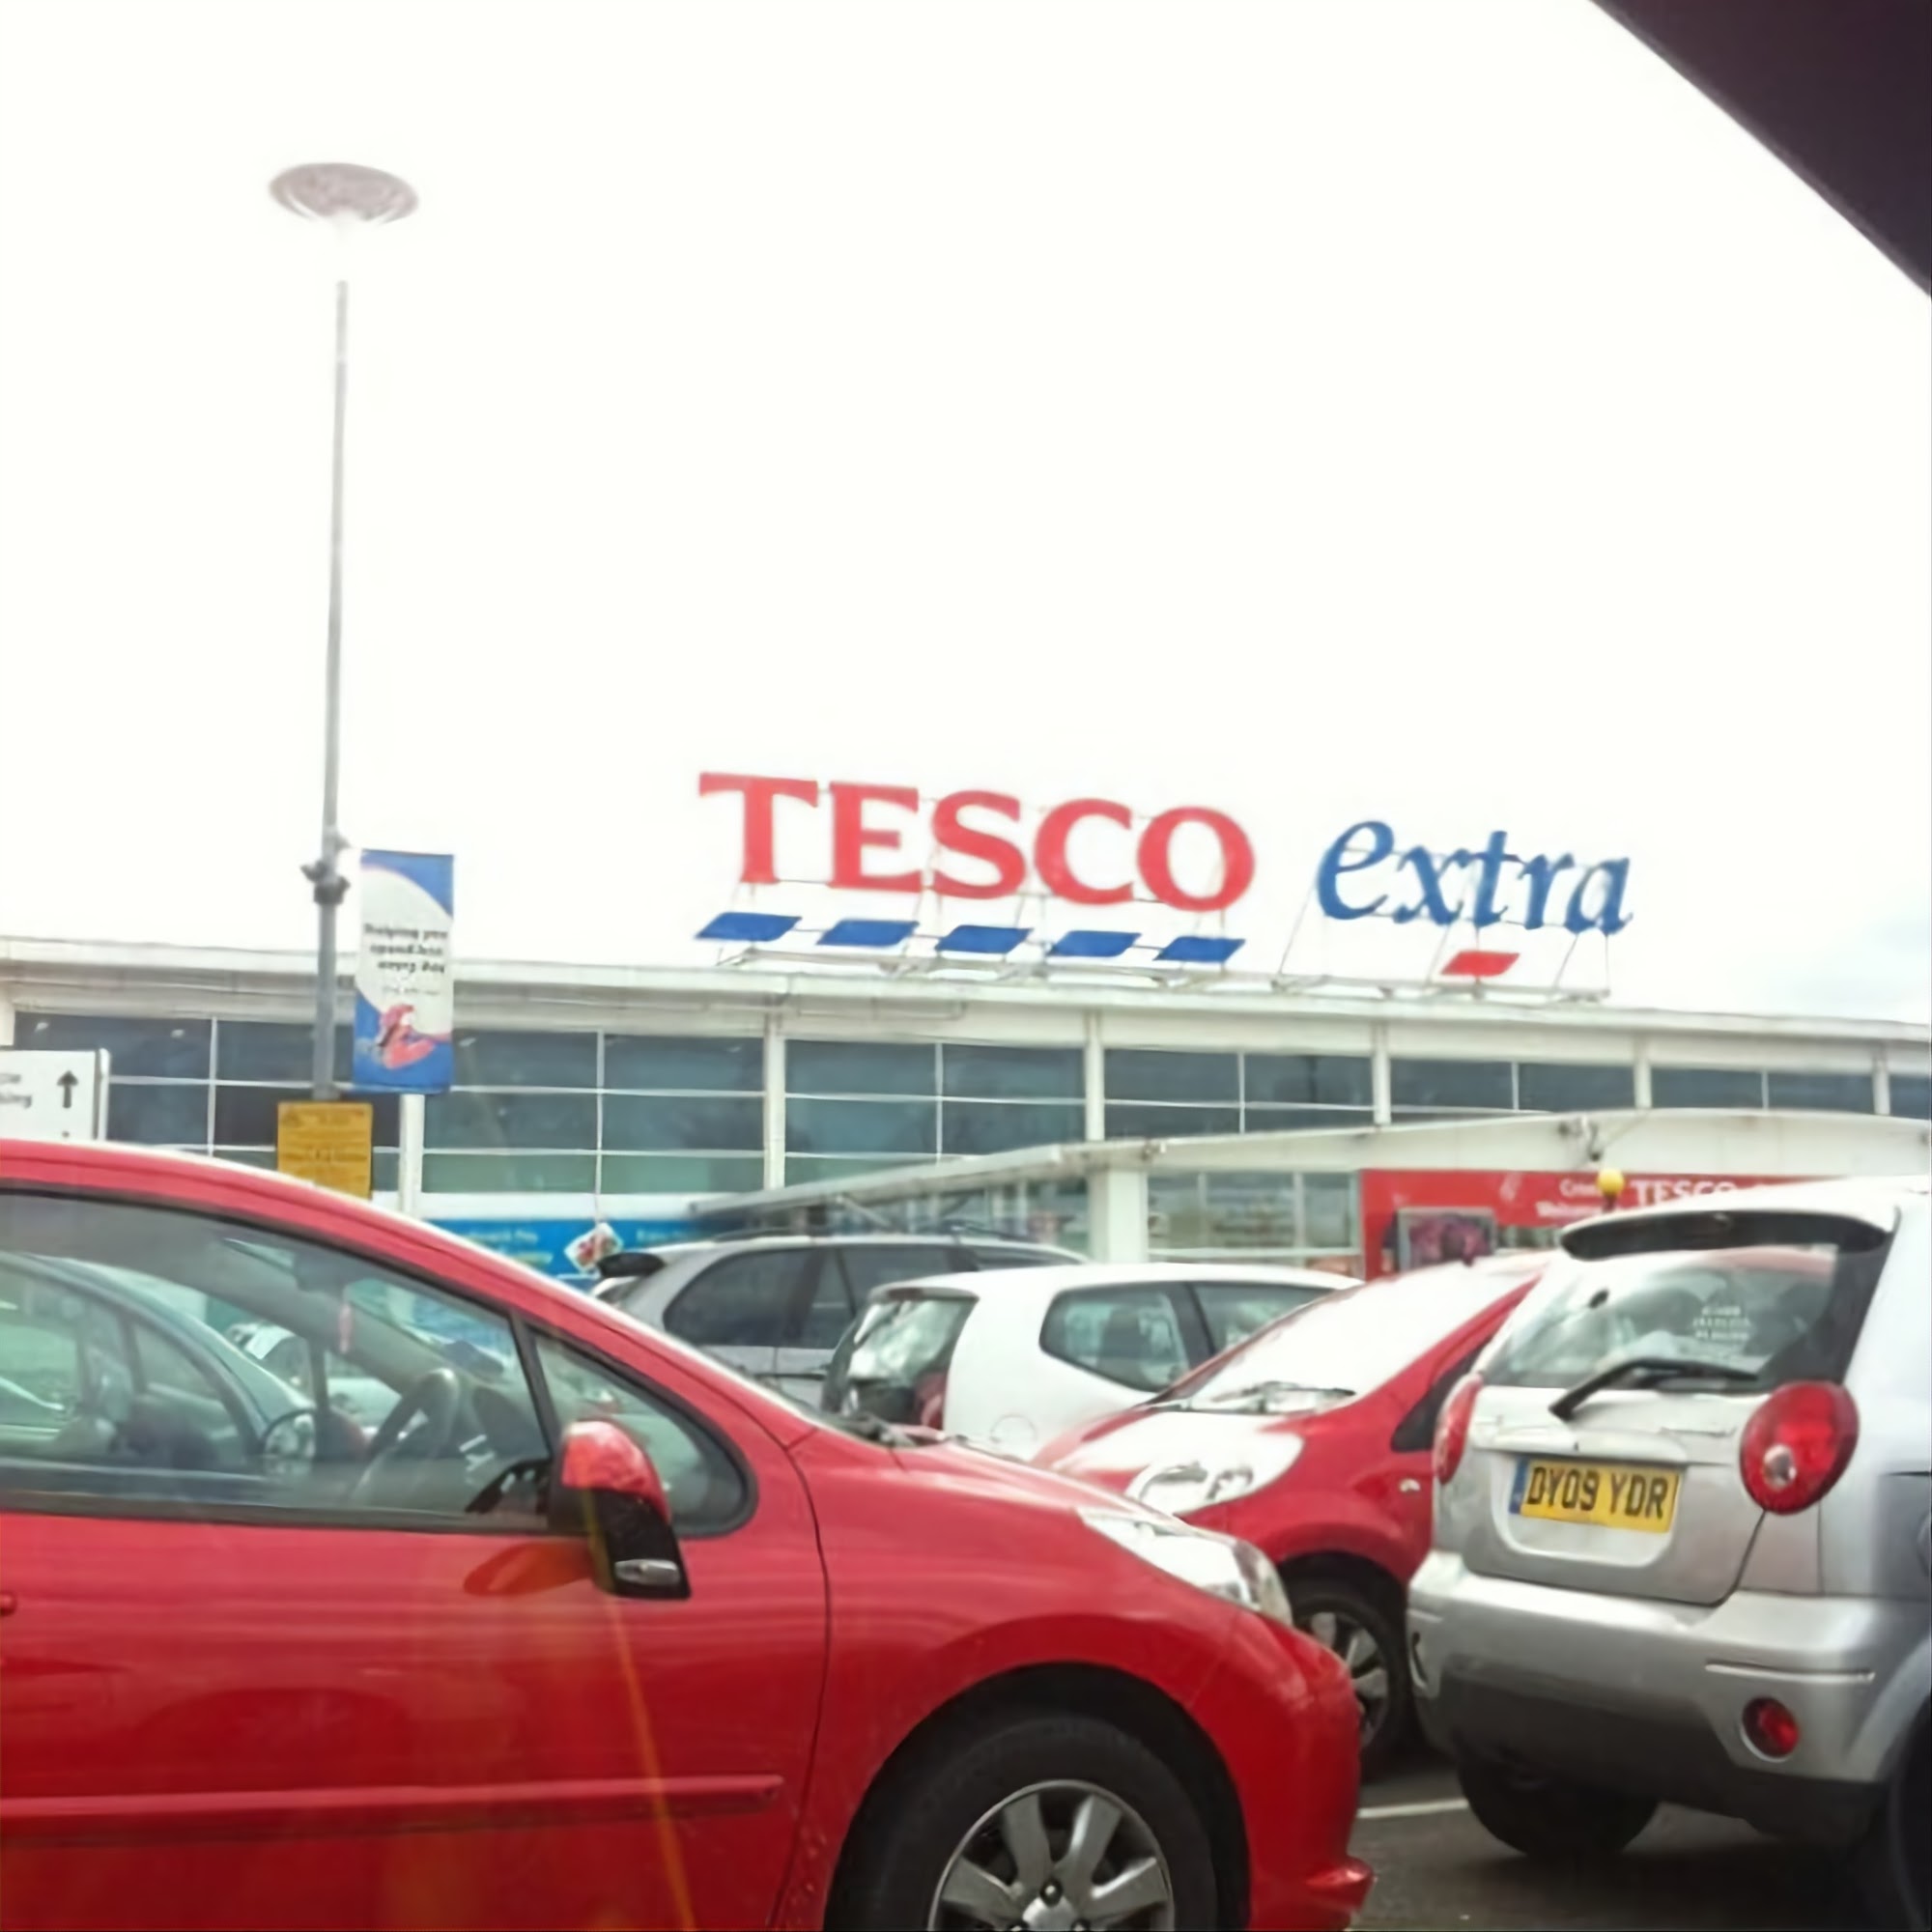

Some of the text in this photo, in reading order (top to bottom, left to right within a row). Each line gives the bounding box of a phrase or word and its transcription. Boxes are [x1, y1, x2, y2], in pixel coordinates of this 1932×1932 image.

[698, 773, 1633, 935] TESCO extra
[1526, 1466, 1669, 1520] DY09 YDR
